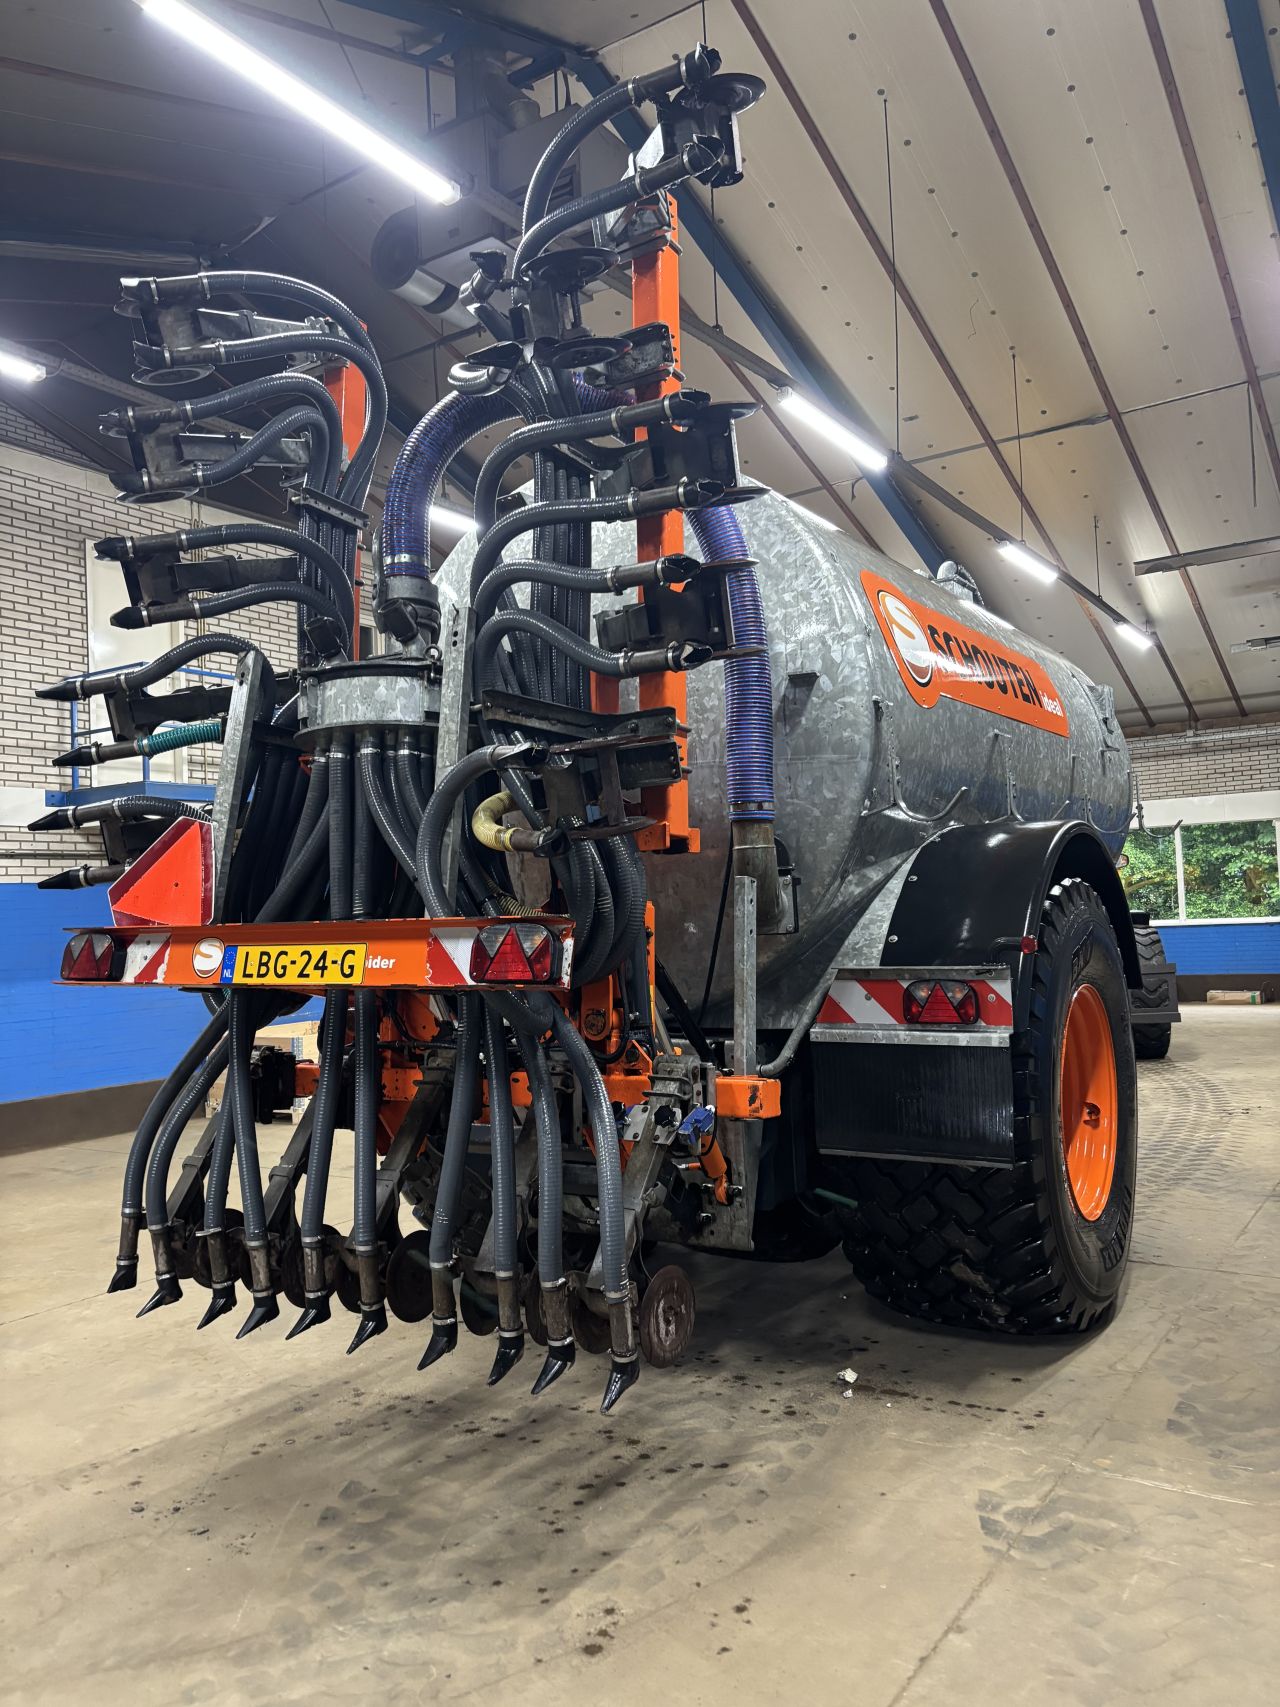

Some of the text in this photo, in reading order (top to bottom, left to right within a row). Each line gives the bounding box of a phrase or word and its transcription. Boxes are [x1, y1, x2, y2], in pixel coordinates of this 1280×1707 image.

[927, 624, 1042, 708] SCHOUTEN
[223, 968, 233, 978] NL
[242, 949, 356, 979] LBG-24-G
[365, 955, 396, 969] ider
